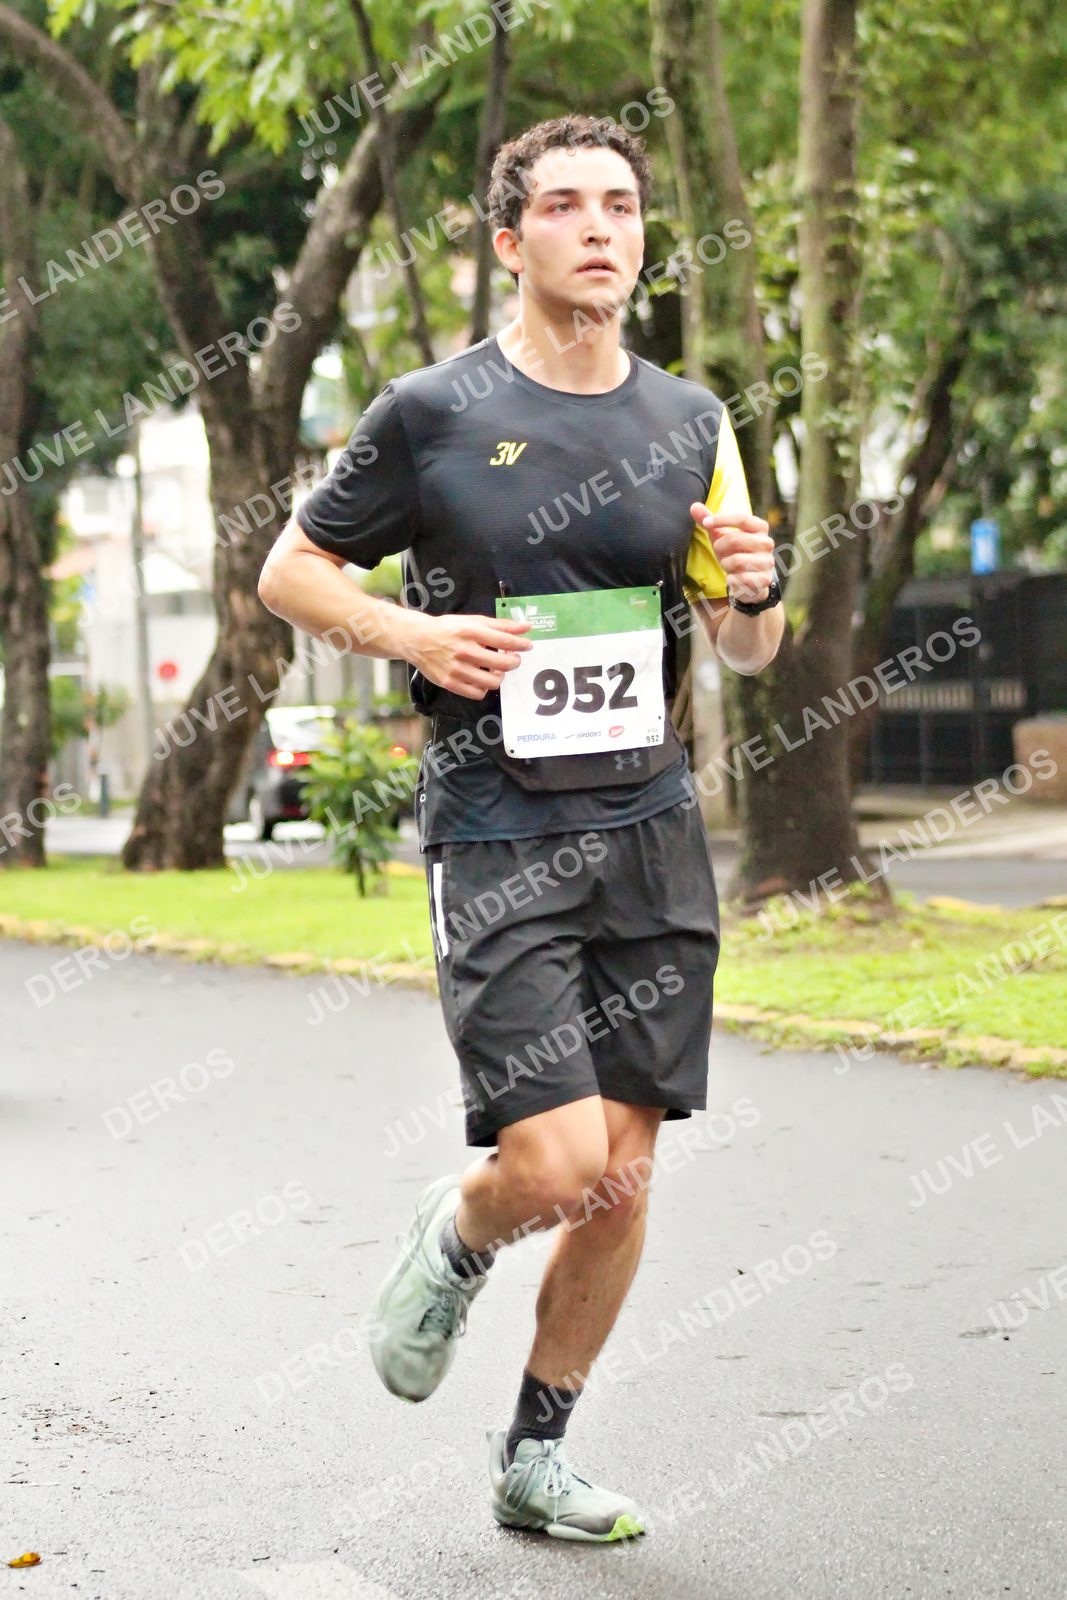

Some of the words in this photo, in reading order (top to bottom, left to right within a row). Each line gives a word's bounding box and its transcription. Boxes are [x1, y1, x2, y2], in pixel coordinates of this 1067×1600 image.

[532, 661, 639, 717] 952
[517, 733, 556, 743] PERDURA
[645, 734, 660, 744] 952
